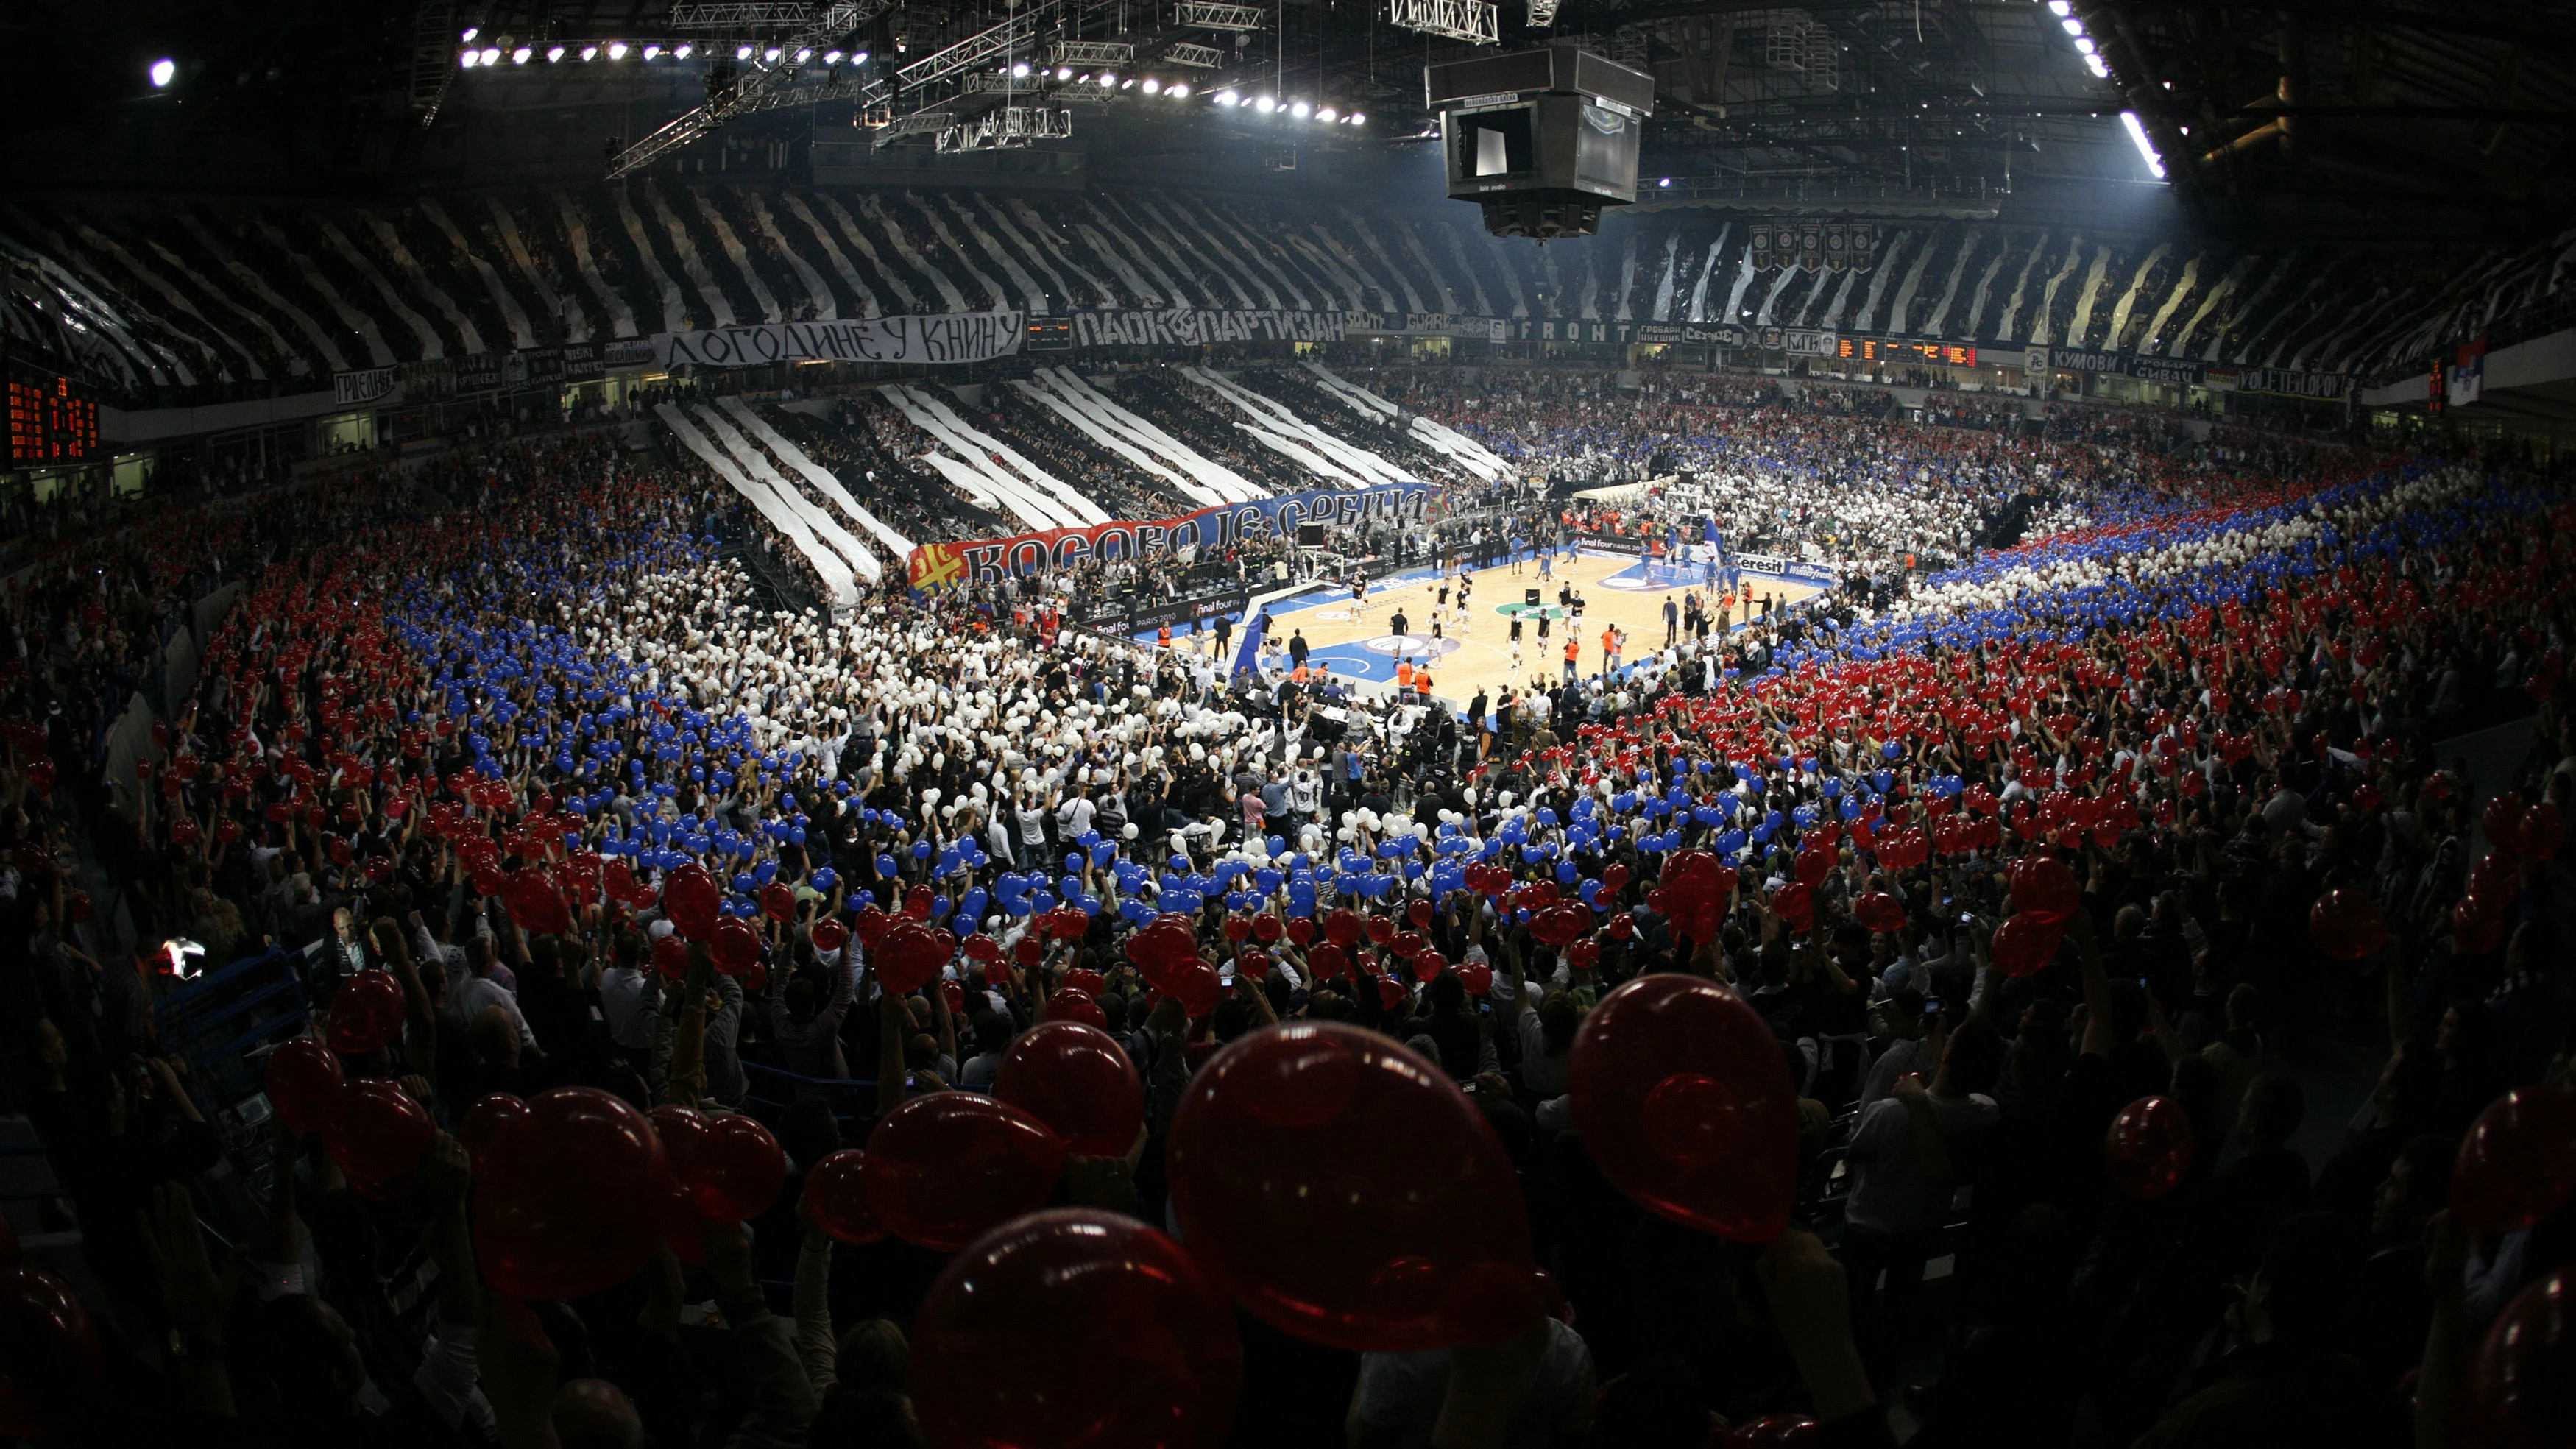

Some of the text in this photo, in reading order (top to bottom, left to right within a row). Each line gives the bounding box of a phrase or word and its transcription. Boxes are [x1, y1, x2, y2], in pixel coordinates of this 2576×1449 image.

[1074, 311, 1175, 347] ПАОК
[1197, 310, 1346, 343] ПАРТИЗАН
[2054, 351, 2117, 372] КУМОВИ
[963, 512, 1201, 587] КОСОВО
[1597, 539, 1613, 548] four
[1215, 600, 1232, 611] four
[1136, 612, 1175, 627] PARIS 2010
[1298, 791, 1309, 801] 10
